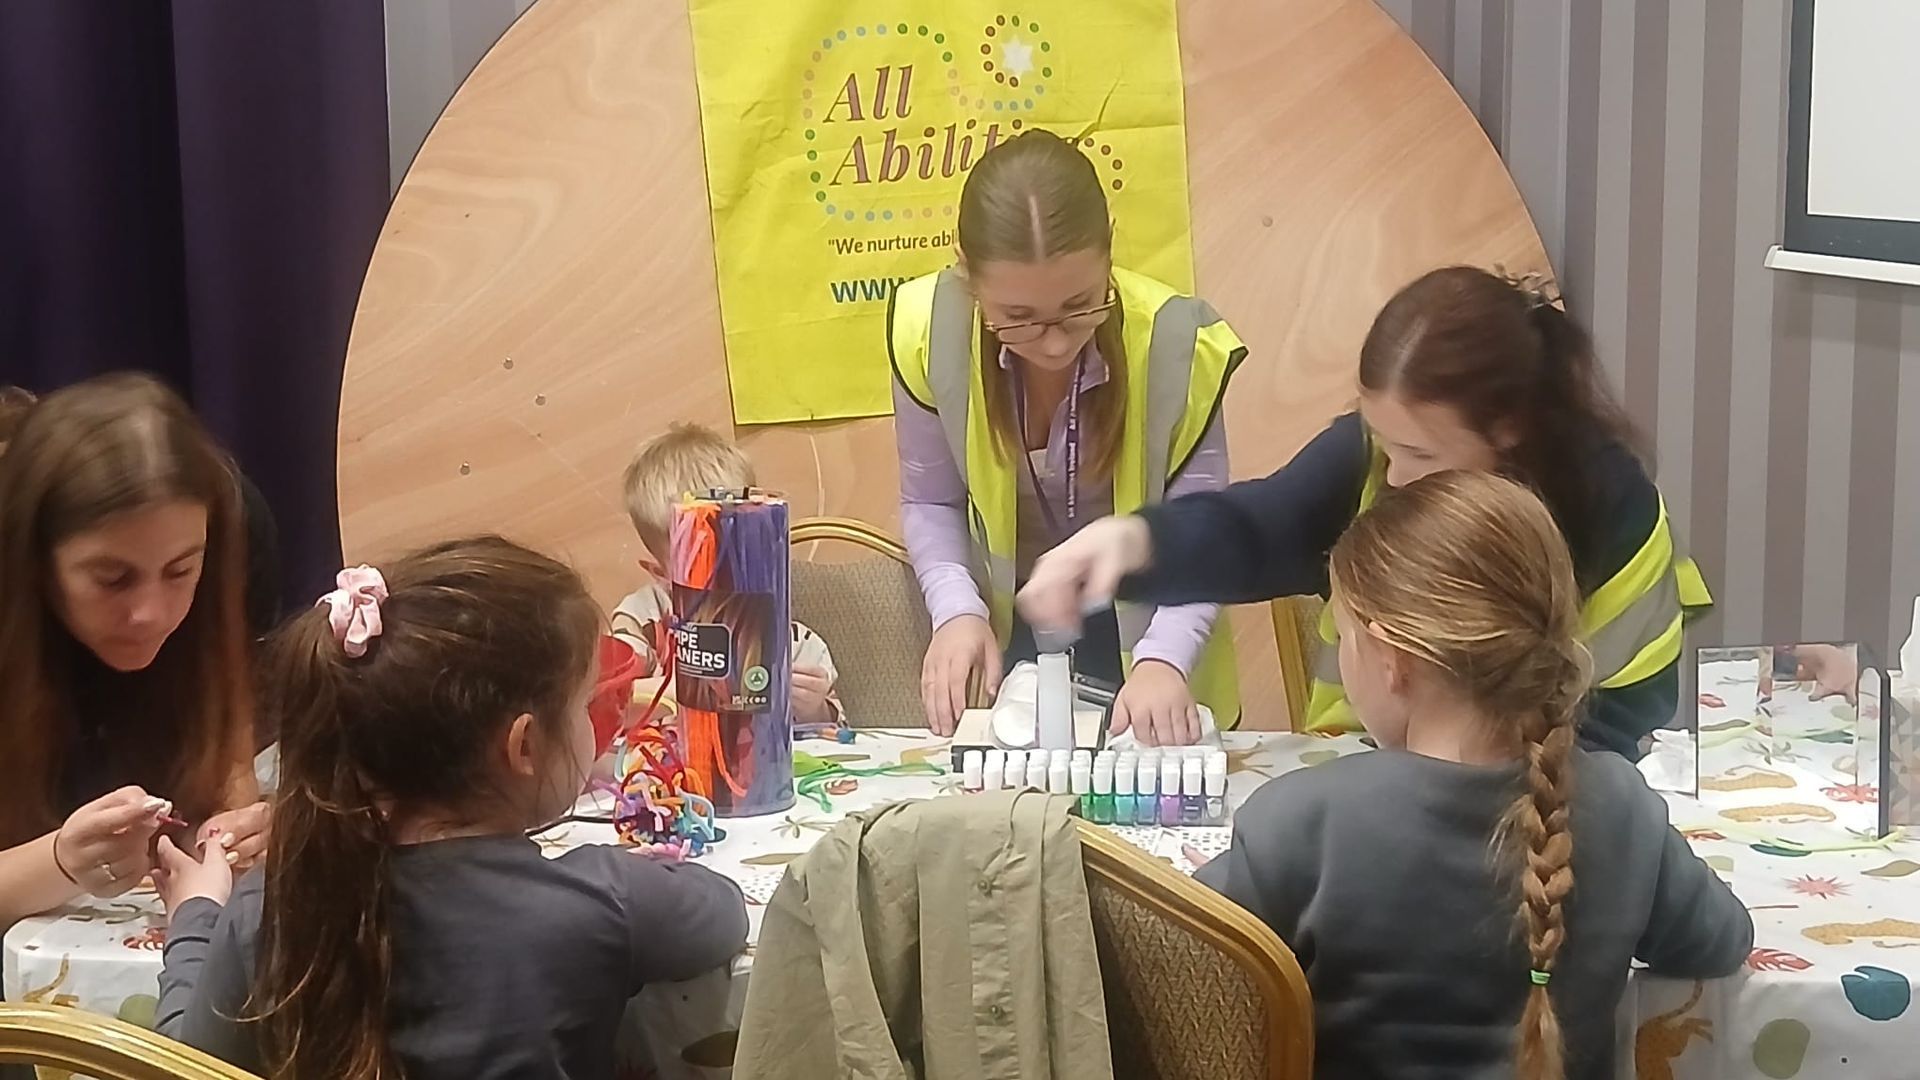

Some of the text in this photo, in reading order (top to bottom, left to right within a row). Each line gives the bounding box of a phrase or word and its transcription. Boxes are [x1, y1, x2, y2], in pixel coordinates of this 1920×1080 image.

[822, 64, 913, 123] All
[829, 118, 1022, 186] Abilit
[828, 237, 864, 255] "We
[867, 234, 928, 253] nurture
[675, 630, 698, 649] IPE
[677, 645, 726, 670] ANERS
